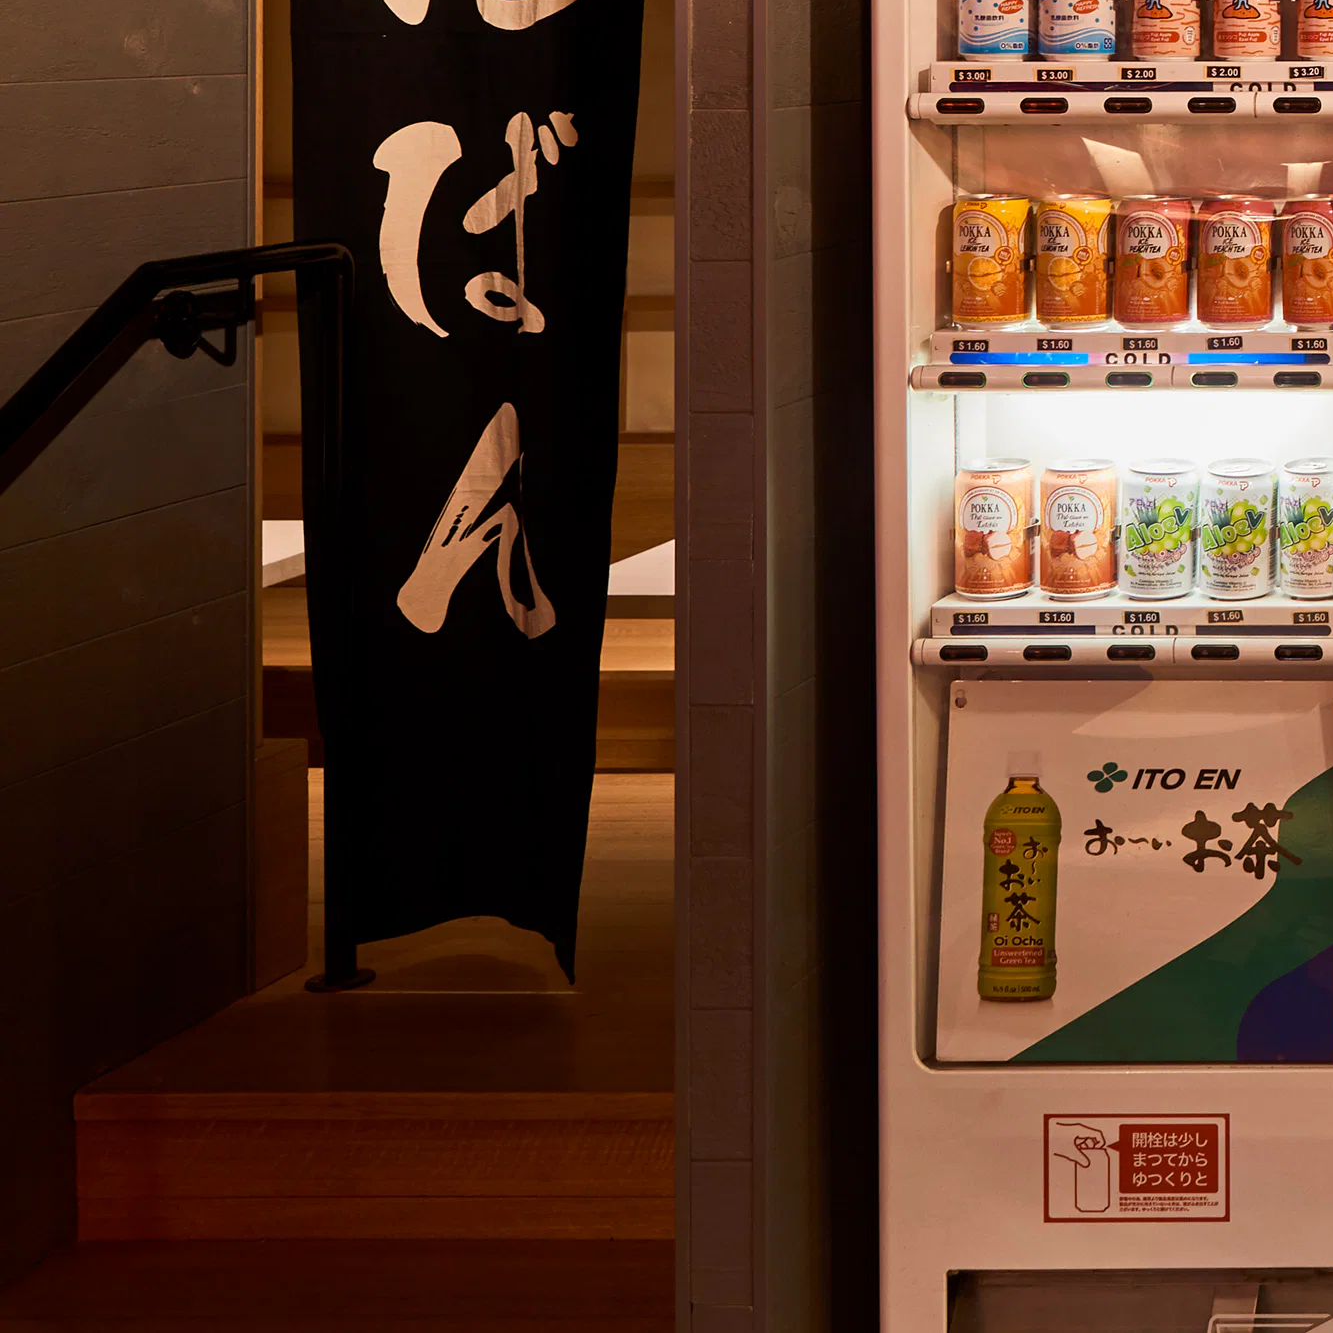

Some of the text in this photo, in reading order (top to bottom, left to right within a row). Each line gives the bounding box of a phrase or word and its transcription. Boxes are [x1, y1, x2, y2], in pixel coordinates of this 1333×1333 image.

[959, 225, 991, 238] POKKA
[1128, 226, 1163, 239] POKKA
[1149, 245, 1161, 253] TEA
[1106, 353, 1171, 365] COLD
[970, 503, 1000, 513] POKKA
[1132, 768, 1242, 791] ITO EN
[994, 935, 1043, 946] Oi Ocha
[993, 949, 1043, 957] Unsweetened
[999, 957, 1036, 965] Green Tea
[1132, 1132, 1208, 1148] 開栓は少し
